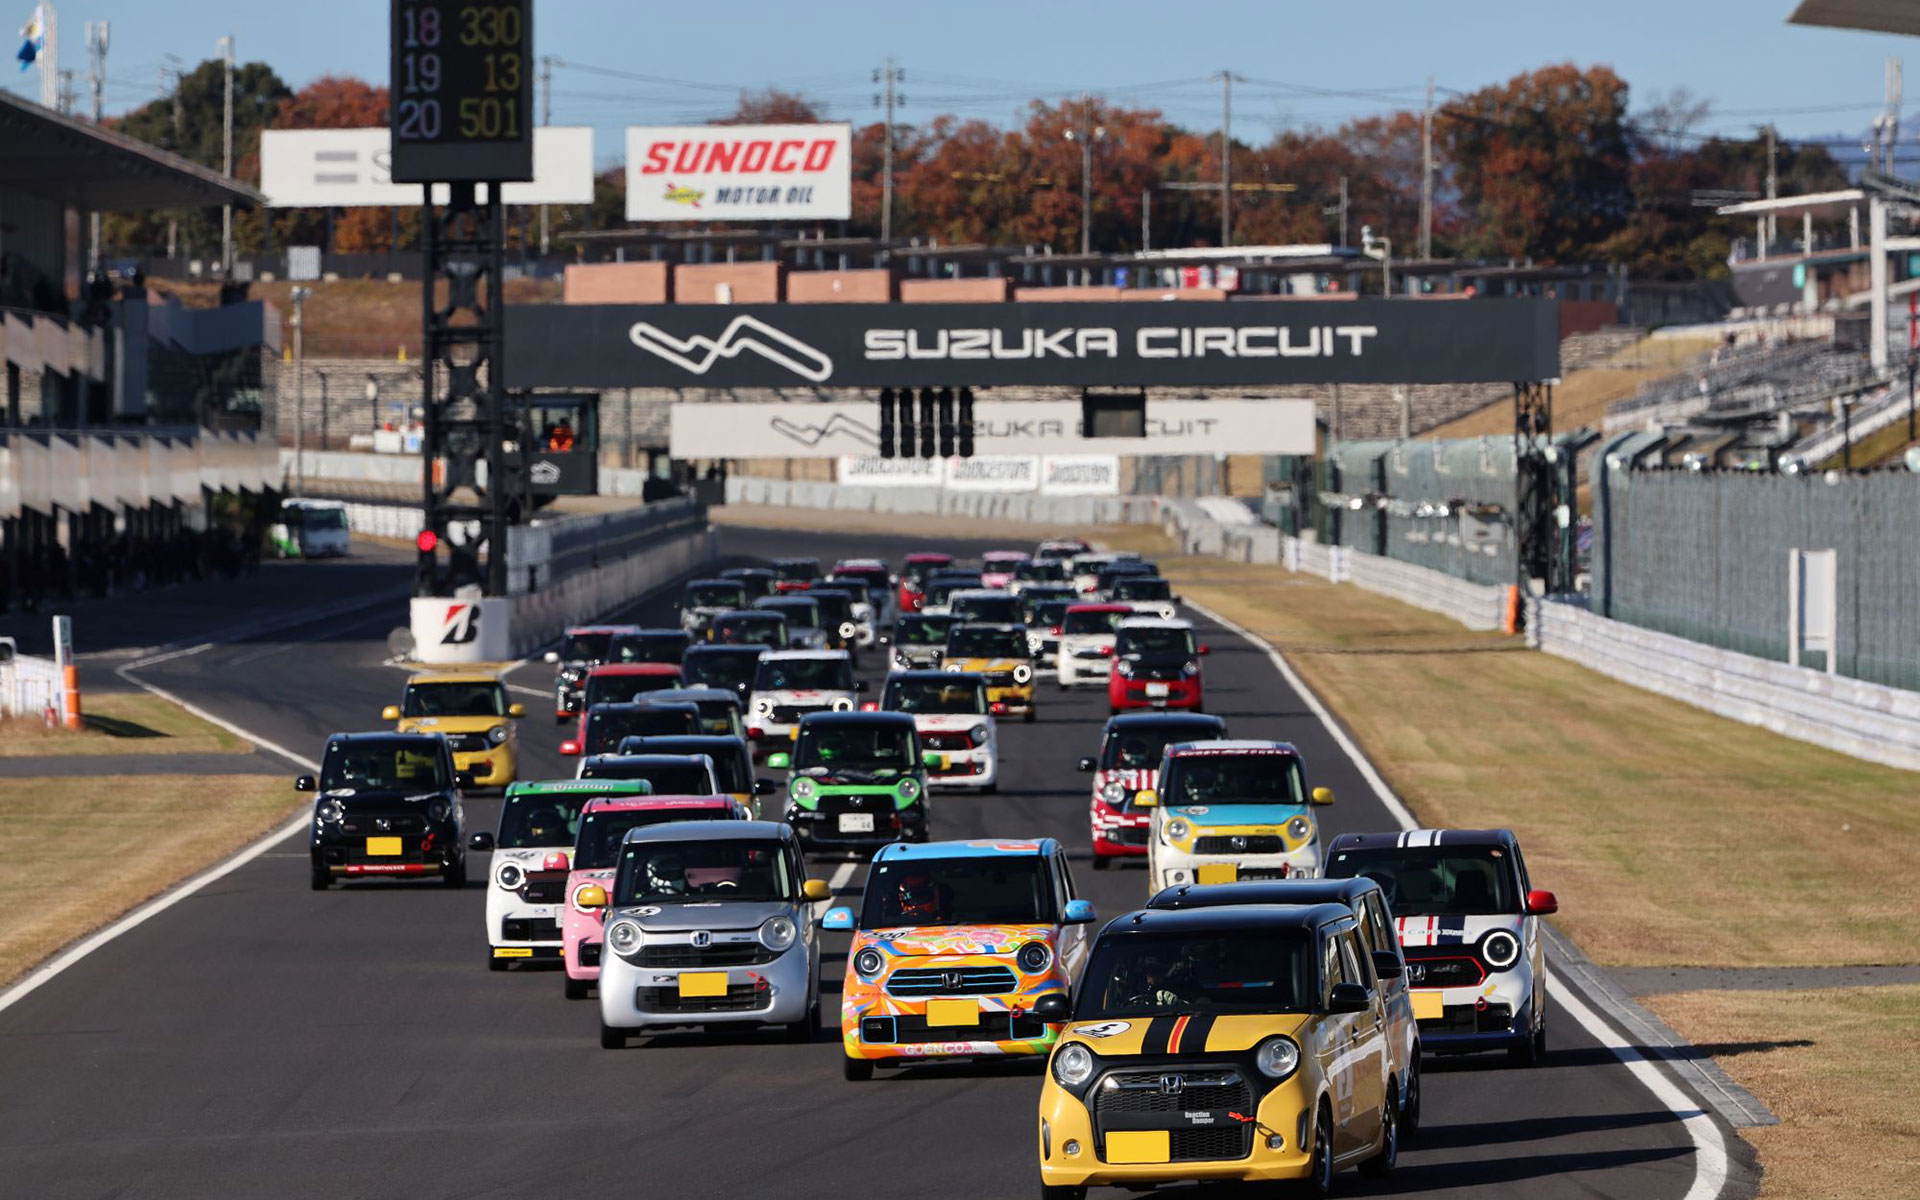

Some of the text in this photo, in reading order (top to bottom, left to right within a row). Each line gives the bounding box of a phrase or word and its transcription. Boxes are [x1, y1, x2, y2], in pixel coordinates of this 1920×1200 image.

[402, 6, 521, 47] 18 330
[402, 53, 521, 93] 19 13
[399, 98, 520, 139] 20 501
[641, 139, 838, 175] SUNOCO
[715, 185, 782, 204] MOTOR
[786, 185, 813, 204] OIL
[863, 325, 1378, 360] SUZUKA CIRCUIT
[1091, 1023, 1118, 1033] 5
